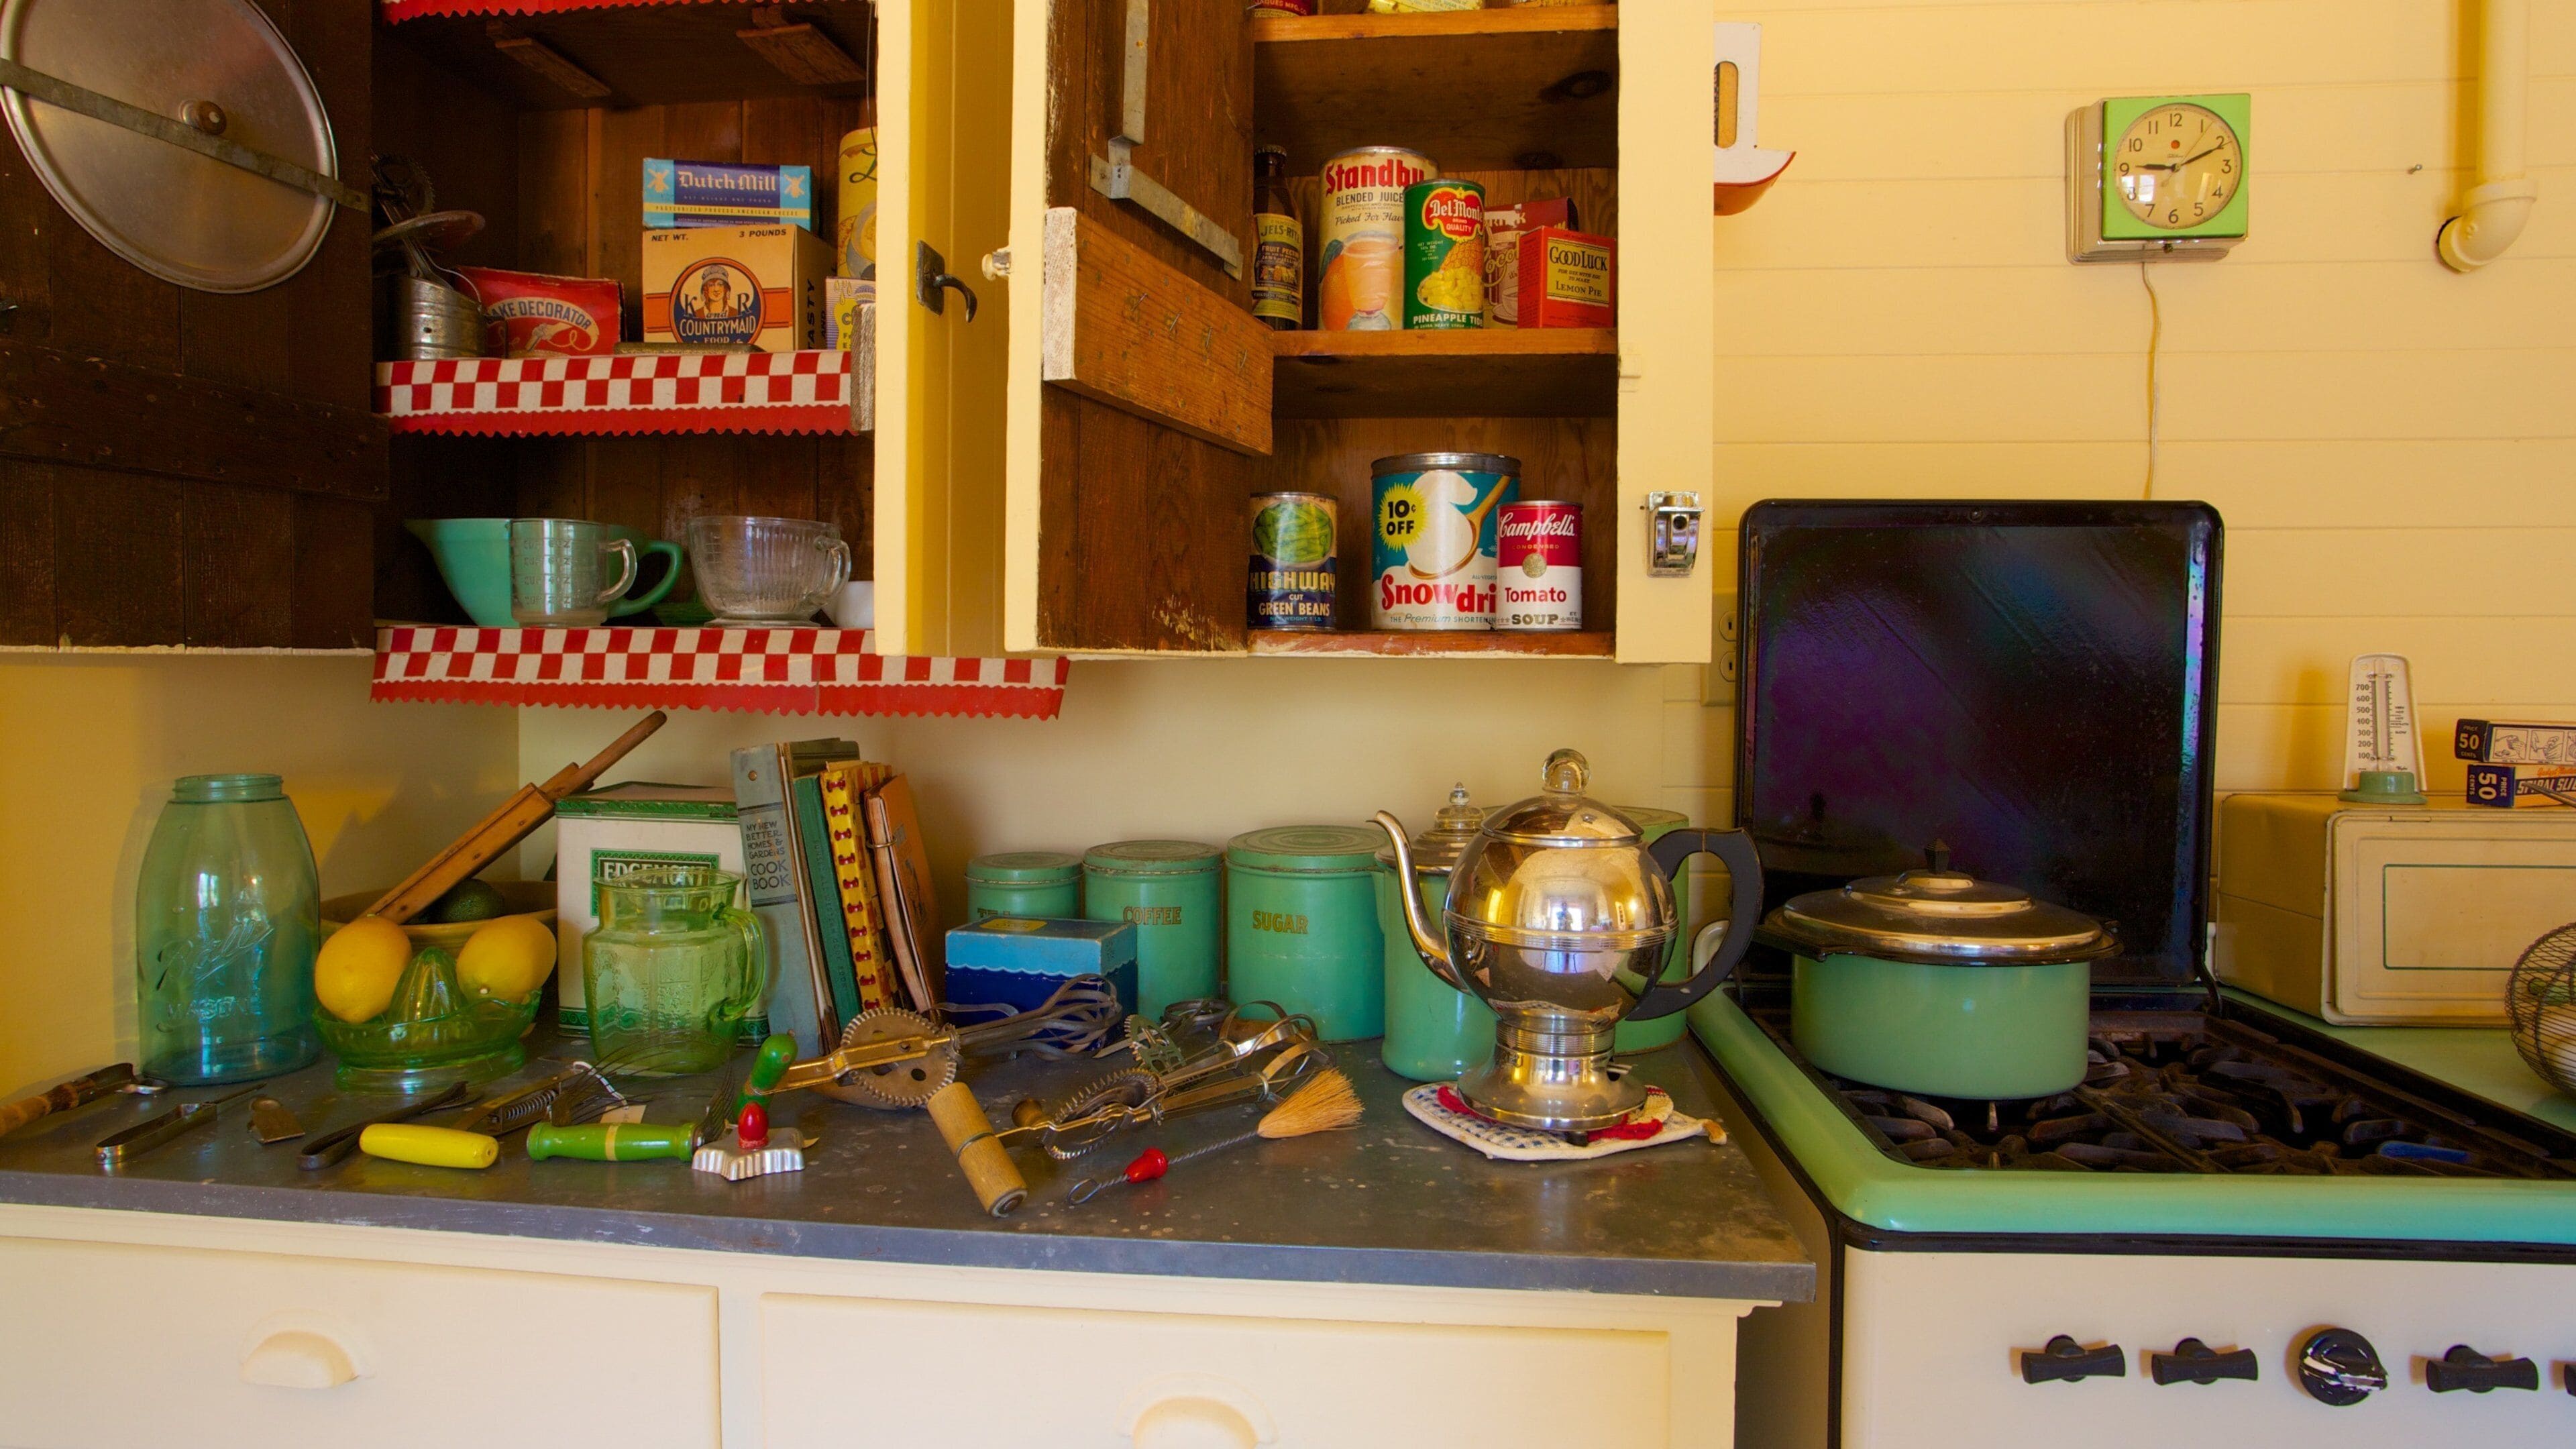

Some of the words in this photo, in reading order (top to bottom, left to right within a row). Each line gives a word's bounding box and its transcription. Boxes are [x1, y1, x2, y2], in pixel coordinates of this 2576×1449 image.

[2169, 113, 2182, 127] 12
[2148, 121, 2158, 134] 11
[2129, 138, 2143, 152] 10
[2216, 136, 2224, 150] 2
[2120, 162, 2129, 176] 9
[2221, 160, 2231, 174] 3
[678, 171, 735, 190] Dutch
[739, 174, 776, 191] Mill
[2127, 187, 2137, 201] 8
[2212, 186, 2222, 198] 4
[1336, 192, 1373, 207] BLENDED
[2145, 204, 2155, 217] 7
[2169, 209, 2178, 223] 6
[2194, 203, 2204, 217] 5
[1336, 213, 1361, 226] Picked
[1364, 213, 1379, 221] For
[749, 229, 787, 237] POUNDS
[1446, 223, 1472, 232] QUALITY
[1555, 280, 1586, 294] LEMON
[1589, 286, 1602, 297] PIE
[684, 294, 697, 317] K
[706, 311, 728, 319] and
[737, 292, 752, 315] R
[519, 301, 592, 329] DECORATOR
[1413, 313, 1466, 324] PINEAPPLE
[680, 315, 757, 336] COUNTRYMAID
[1386, 521, 1415, 536] OFF
[1499, 512, 1576, 541] Campbell's
[1250, 571, 1336, 592] HIGHWAY
[1289, 593, 1304, 601] CUT
[1505, 586, 1567, 603] Tomato
[1259, 602, 1293, 616] GREEN
[1299, 602, 1330, 616] BEANS
[1403, 613, 1450, 624] Premium
[1511, 613, 1559, 626] SOUP
[2459, 733, 2479, 750] 50
[2478, 773, 2497, 800] 50
[759, 821, 777, 830] NEW
[746, 830, 782, 841] BETTER
[747, 841, 772, 850] HOMES
[749, 847, 785, 859] GARDENS
[751, 859, 788, 875] COOK
[753, 874, 791, 890] BOOK
[1123, 906, 1182, 926] COFFEE
[1252, 910, 1308, 934] SUGAR
